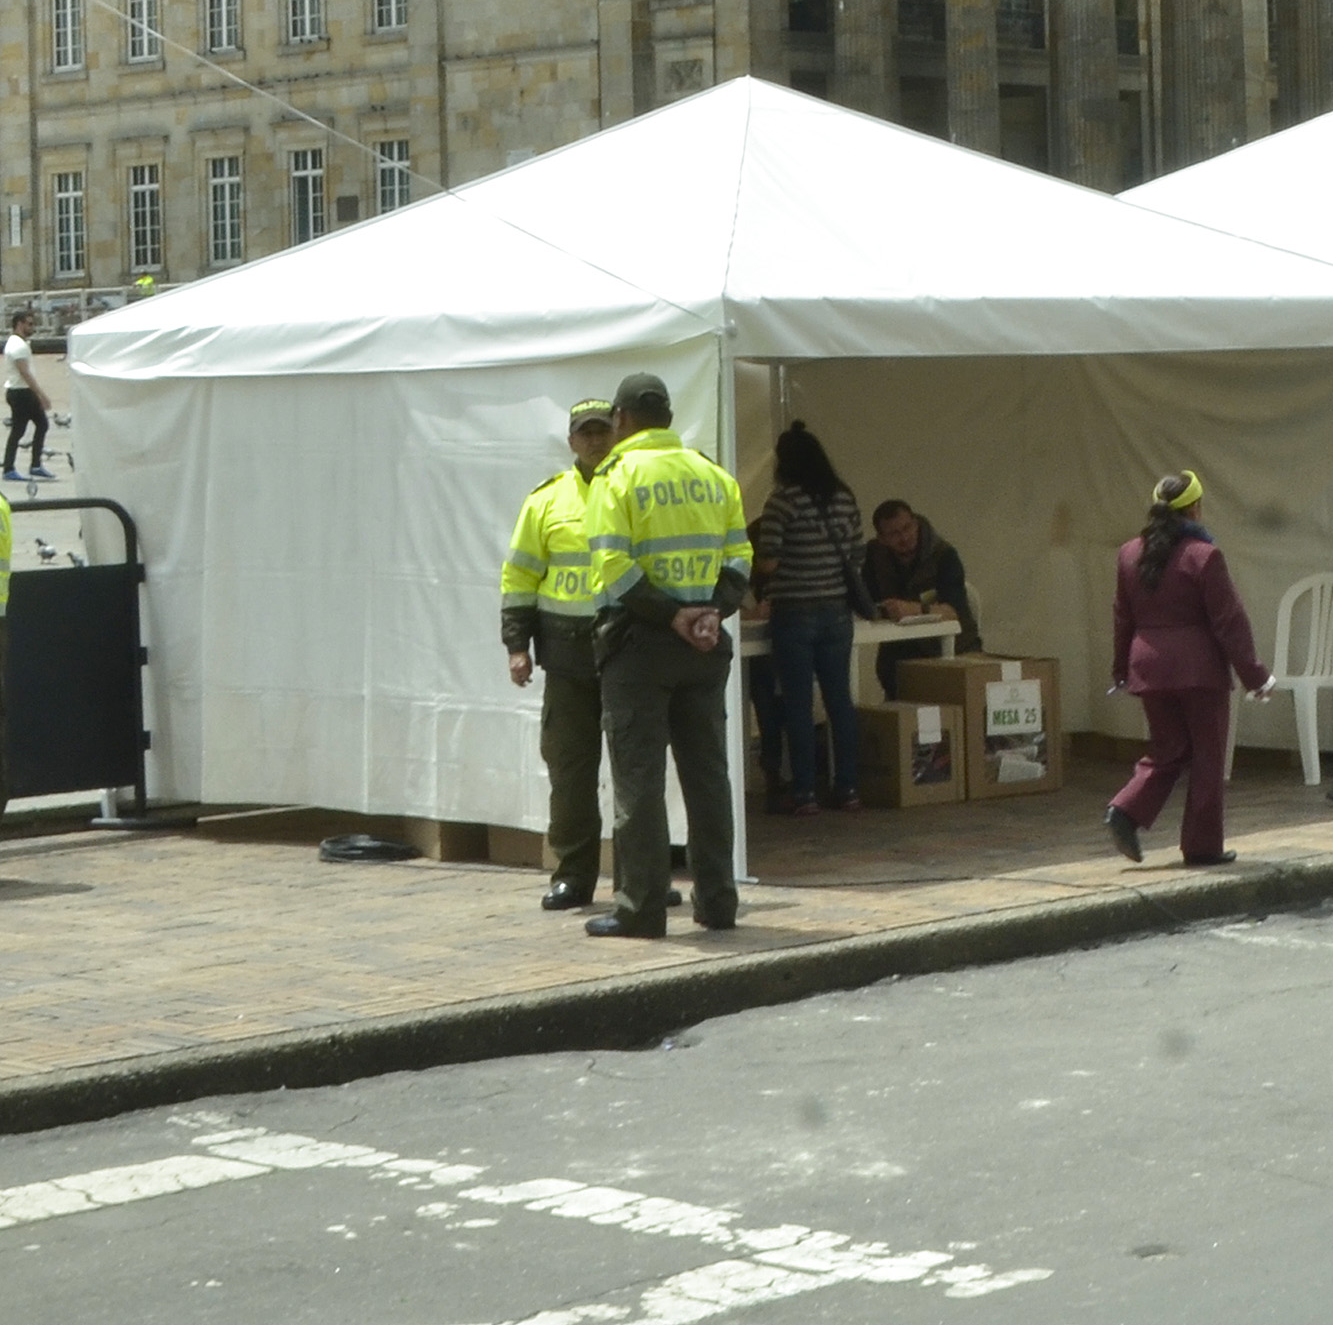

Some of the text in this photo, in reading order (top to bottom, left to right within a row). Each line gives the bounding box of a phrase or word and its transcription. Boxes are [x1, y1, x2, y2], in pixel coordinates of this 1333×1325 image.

[634, 478, 724, 511] POLICIA
[992, 707, 1037, 725] MESA 25
